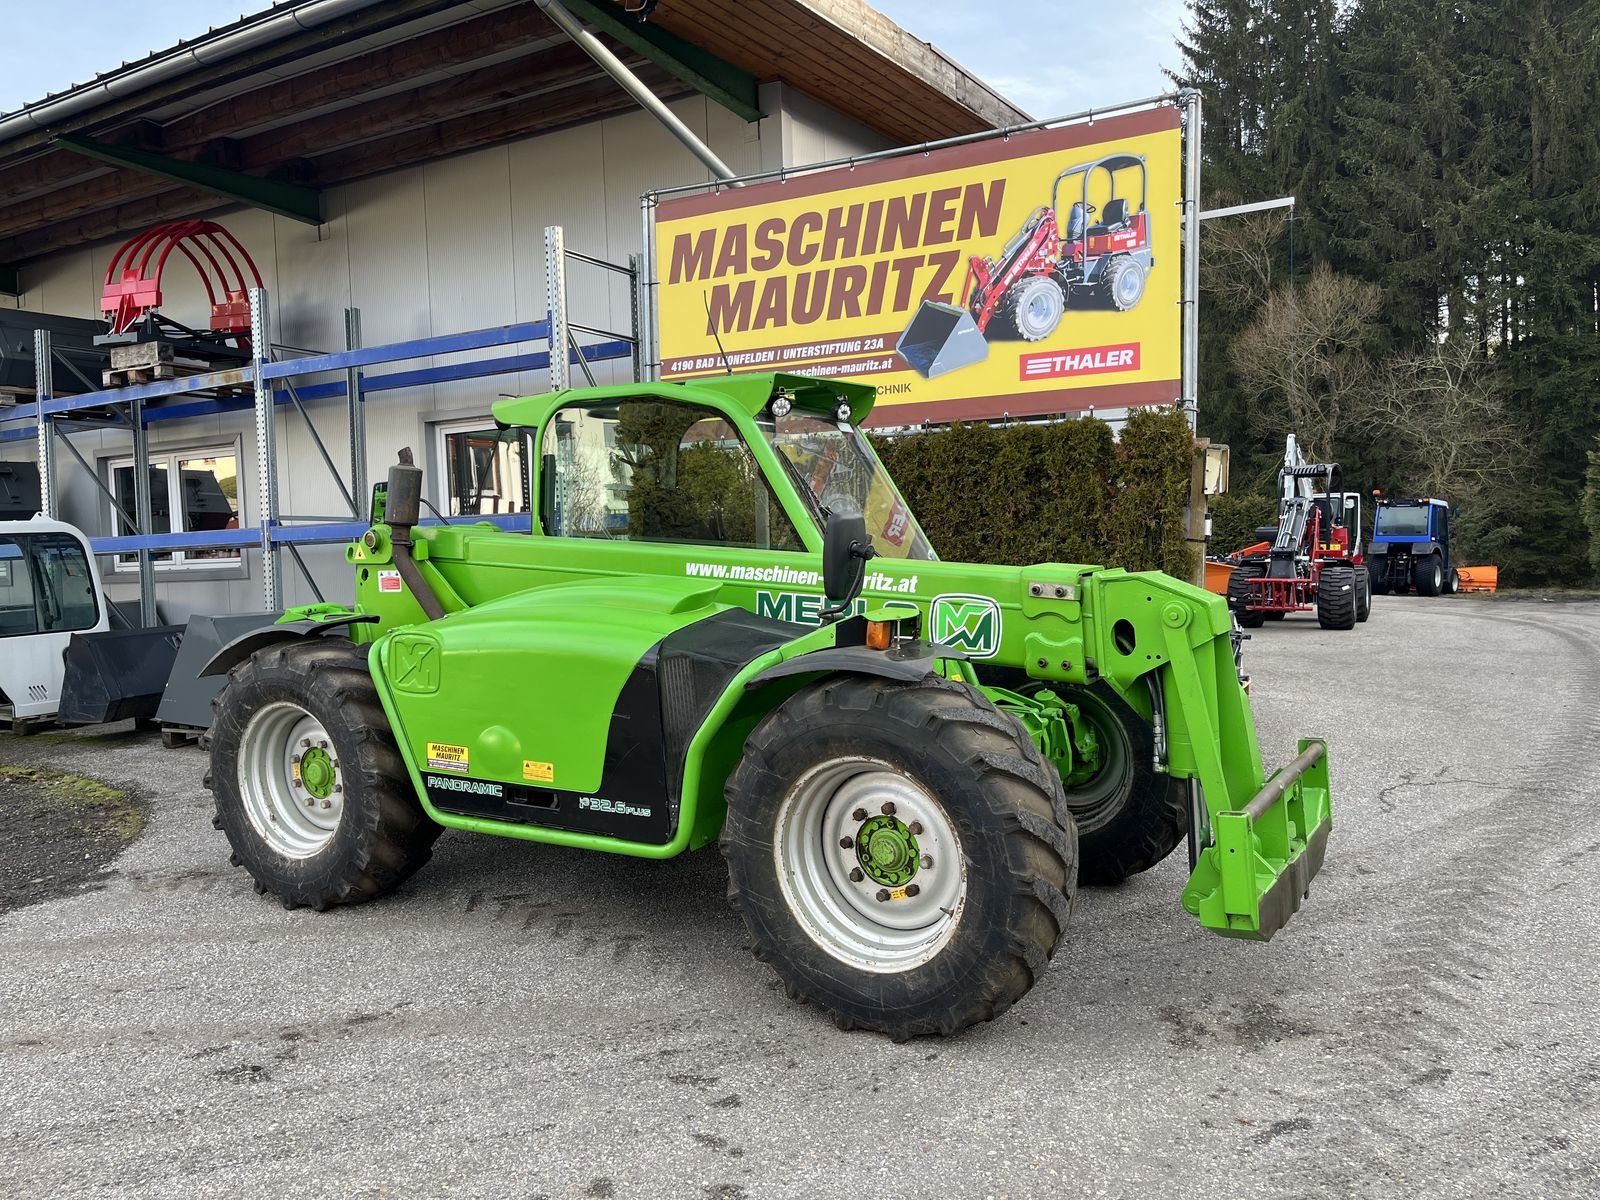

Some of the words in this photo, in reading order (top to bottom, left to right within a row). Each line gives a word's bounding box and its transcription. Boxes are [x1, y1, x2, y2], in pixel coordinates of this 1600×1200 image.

[669, 178, 1006, 285] MASCHINEN
[706, 249, 961, 337] MAURITZ
[671, 360, 694, 372] 4190
[695, 358, 715, 369] BAD
[716, 352, 774, 367] LEONFELDEN
[783, 341, 862, 359] UNTERSTIFTUNG
[864, 338, 884, 351] 23A
[1050, 348, 1133, 374] THALER
[787, 358, 893, 377] maschinen-mauritz.at
[876, 382, 912, 395] CHNIK
[685, 562, 918, 593] www.maschinen-ritz.at
[431, 744, 465, 754] MASCHINEN
[435, 752, 461, 761] MAURITZ
[427, 776, 503, 797] PANORAMIC
